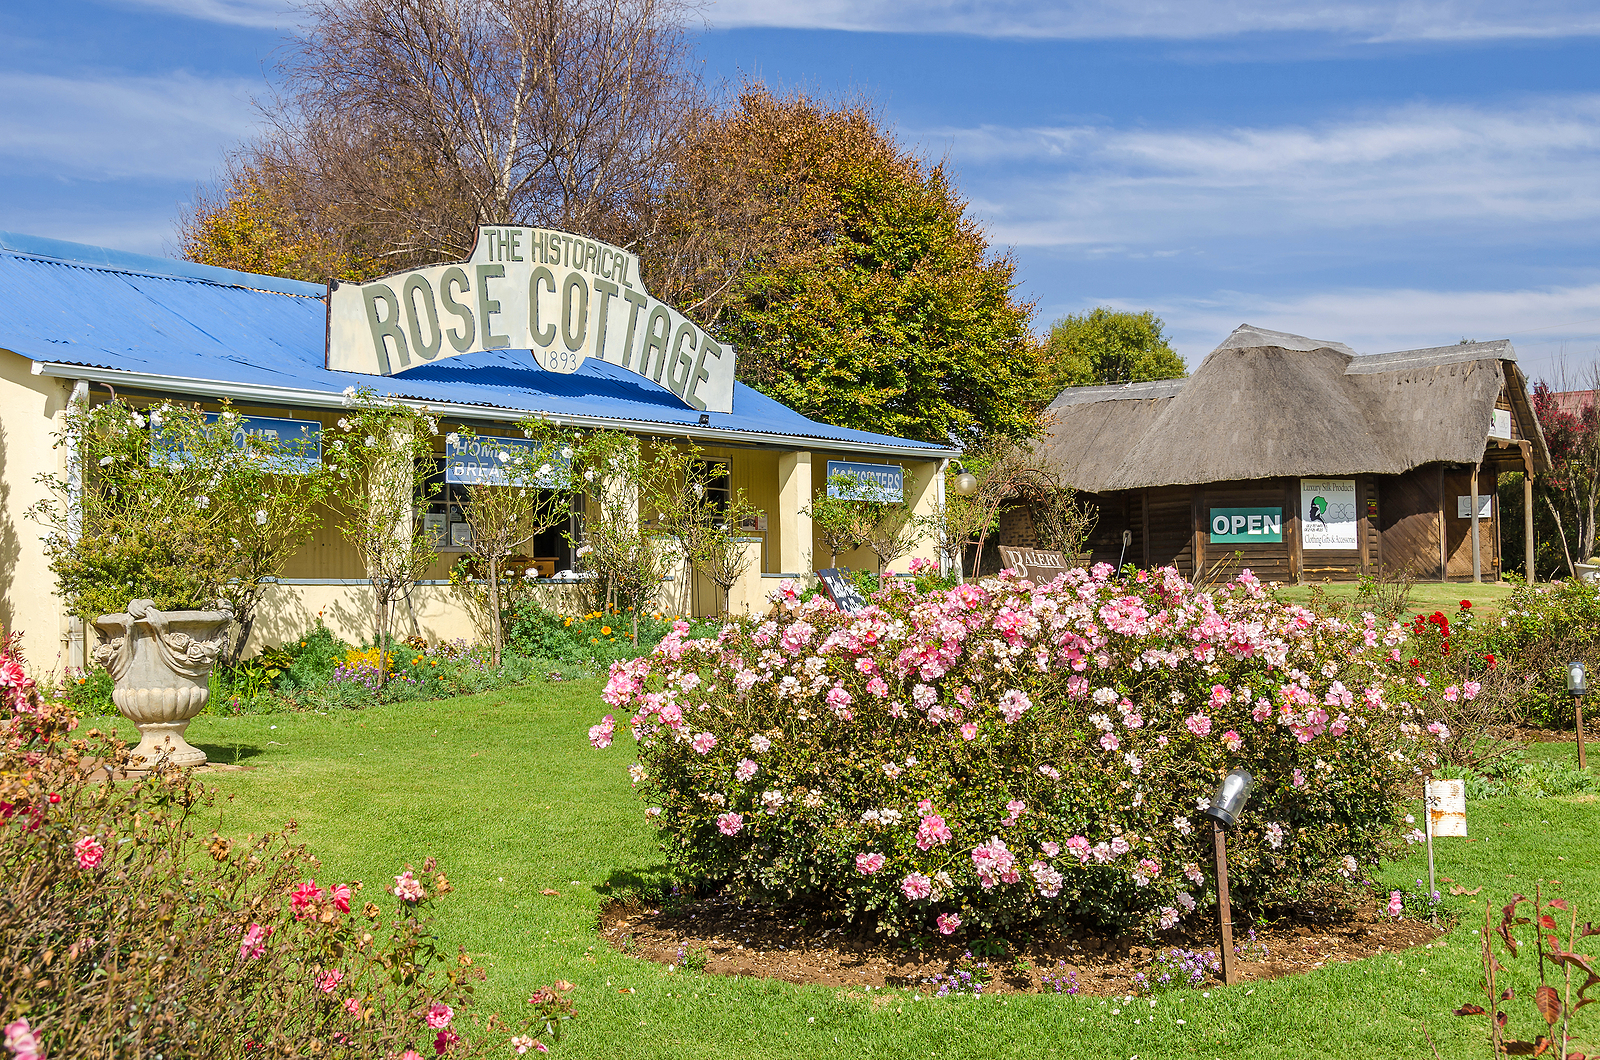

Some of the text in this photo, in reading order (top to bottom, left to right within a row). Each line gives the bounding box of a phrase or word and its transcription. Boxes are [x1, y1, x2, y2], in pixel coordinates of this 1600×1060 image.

[483, 228, 634, 289] THE HISTORICAL
[361, 263, 723, 412] ROSE COTTAGE
[542, 350, 578, 371] 1893
[1303, 482, 1355, 494] Luxury Silk Products
[1212, 514, 1281, 535] OPEN
[1304, 534, 1322, 546] Clothing
